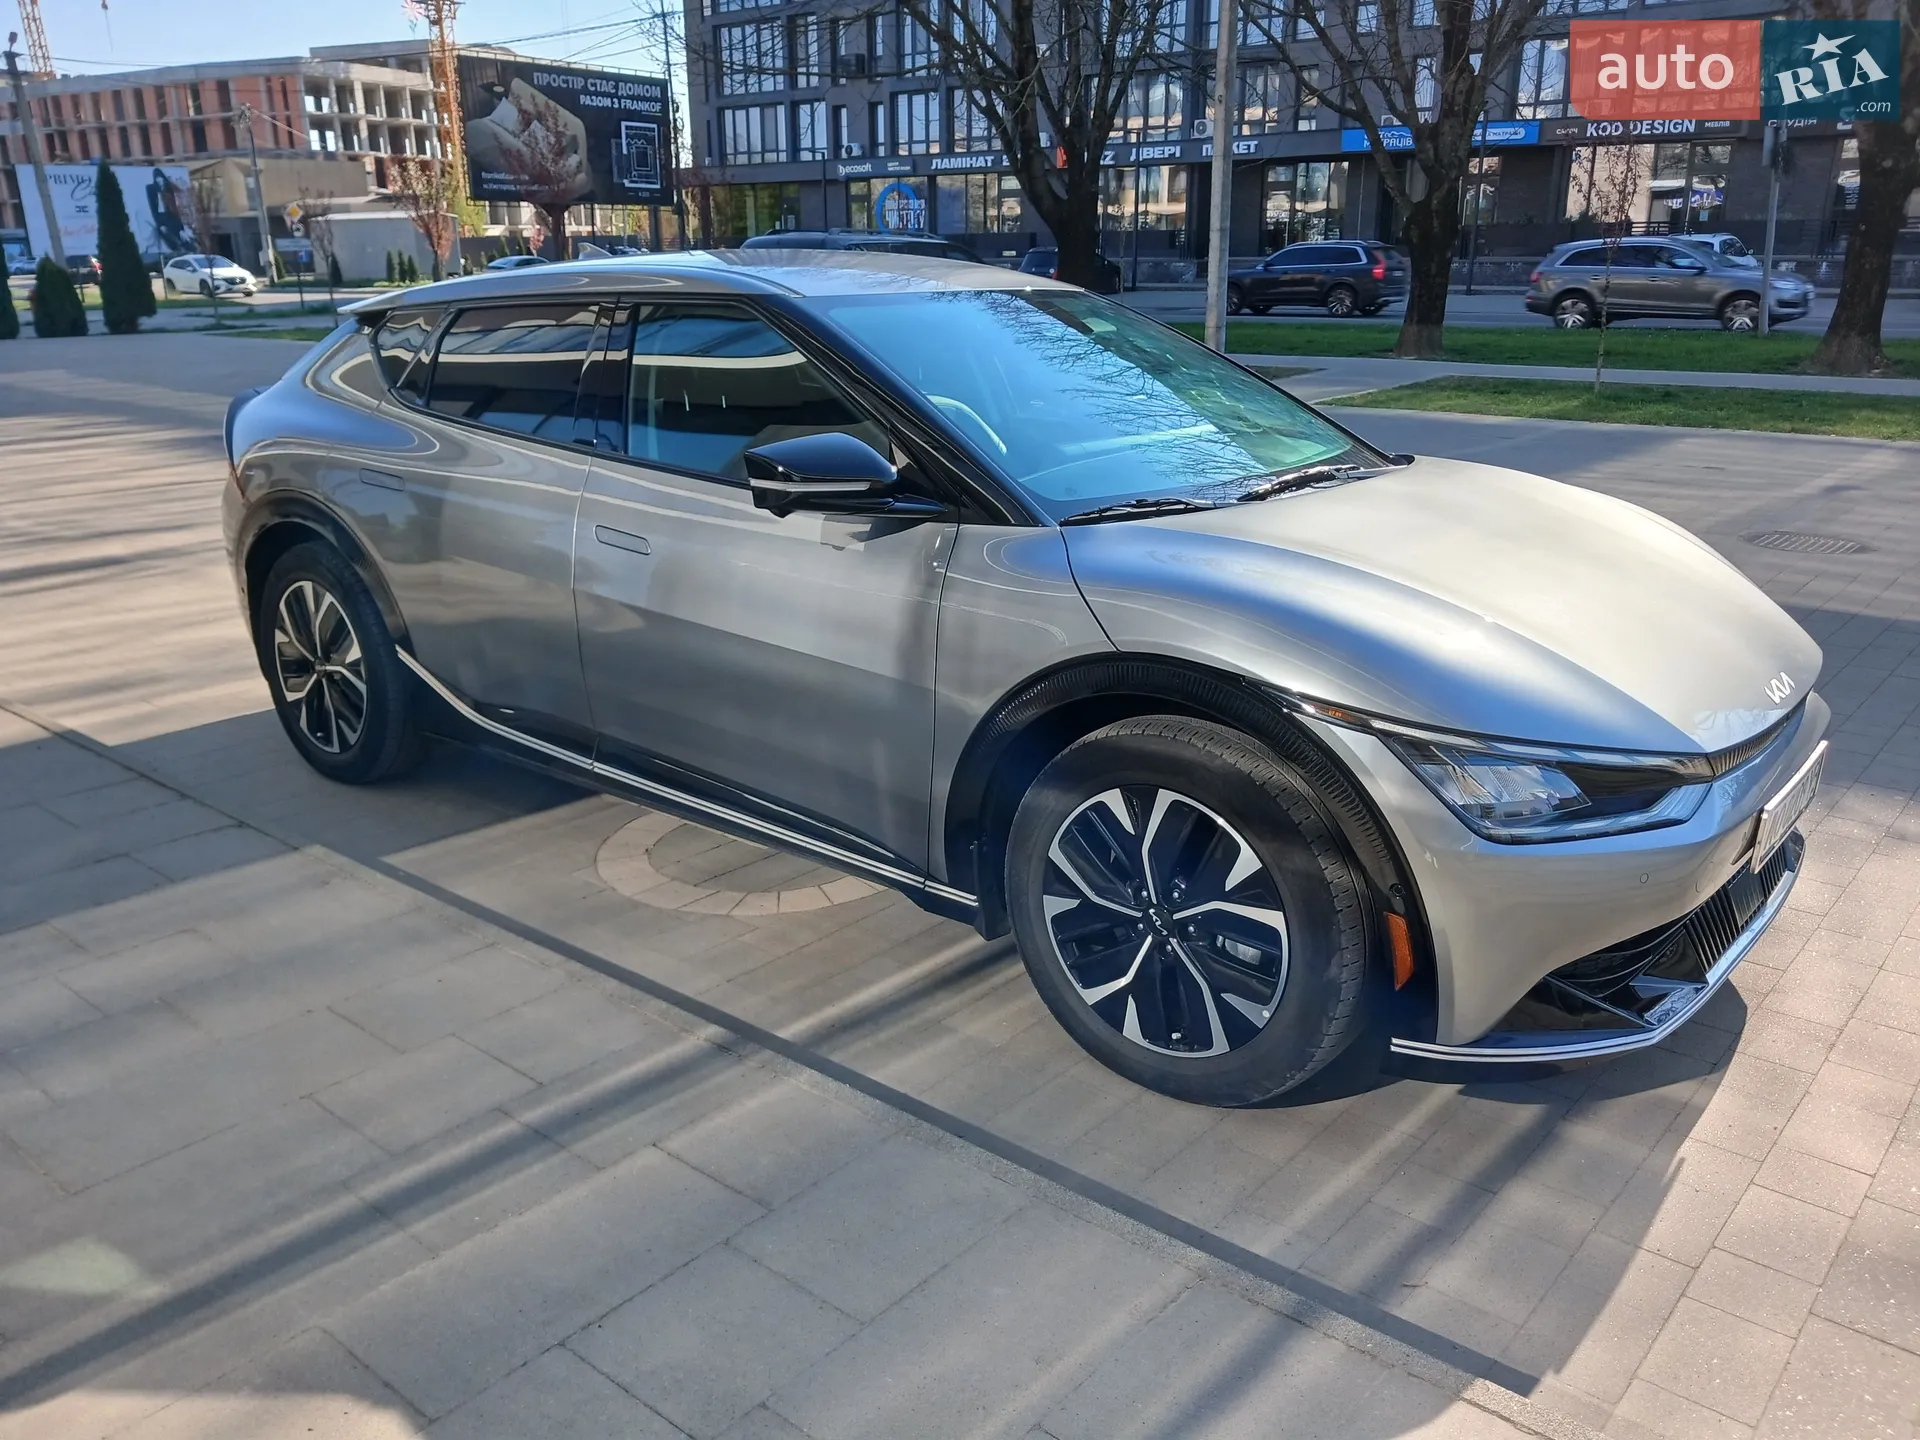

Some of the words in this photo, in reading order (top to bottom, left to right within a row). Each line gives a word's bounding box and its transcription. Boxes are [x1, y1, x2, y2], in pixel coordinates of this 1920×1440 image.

[533, 72, 585, 89] ПРОСТІР
[587, 78, 616, 93] СТАЄ
[618, 82, 661, 98] ДОМОМ
[580, 95, 612, 108] РАЗОМ
[621, 99, 662, 112] FRANKOF
[1586, 122, 1624, 137] KOD
[1630, 119, 1696, 135] DESIGN
[1768, 117, 1817, 127] СУДІЯ
[1202, 141, 1259, 157] ПКЕТ
[1363, 137, 1413, 148] МРАЦІВ
[1130, 145, 1181, 162] ДВЕРІ
[846, 163, 872, 173] ecosoft
[930, 156, 994, 170] ЛАМІНАТ
[1764, 671, 1796, 705] KIA
